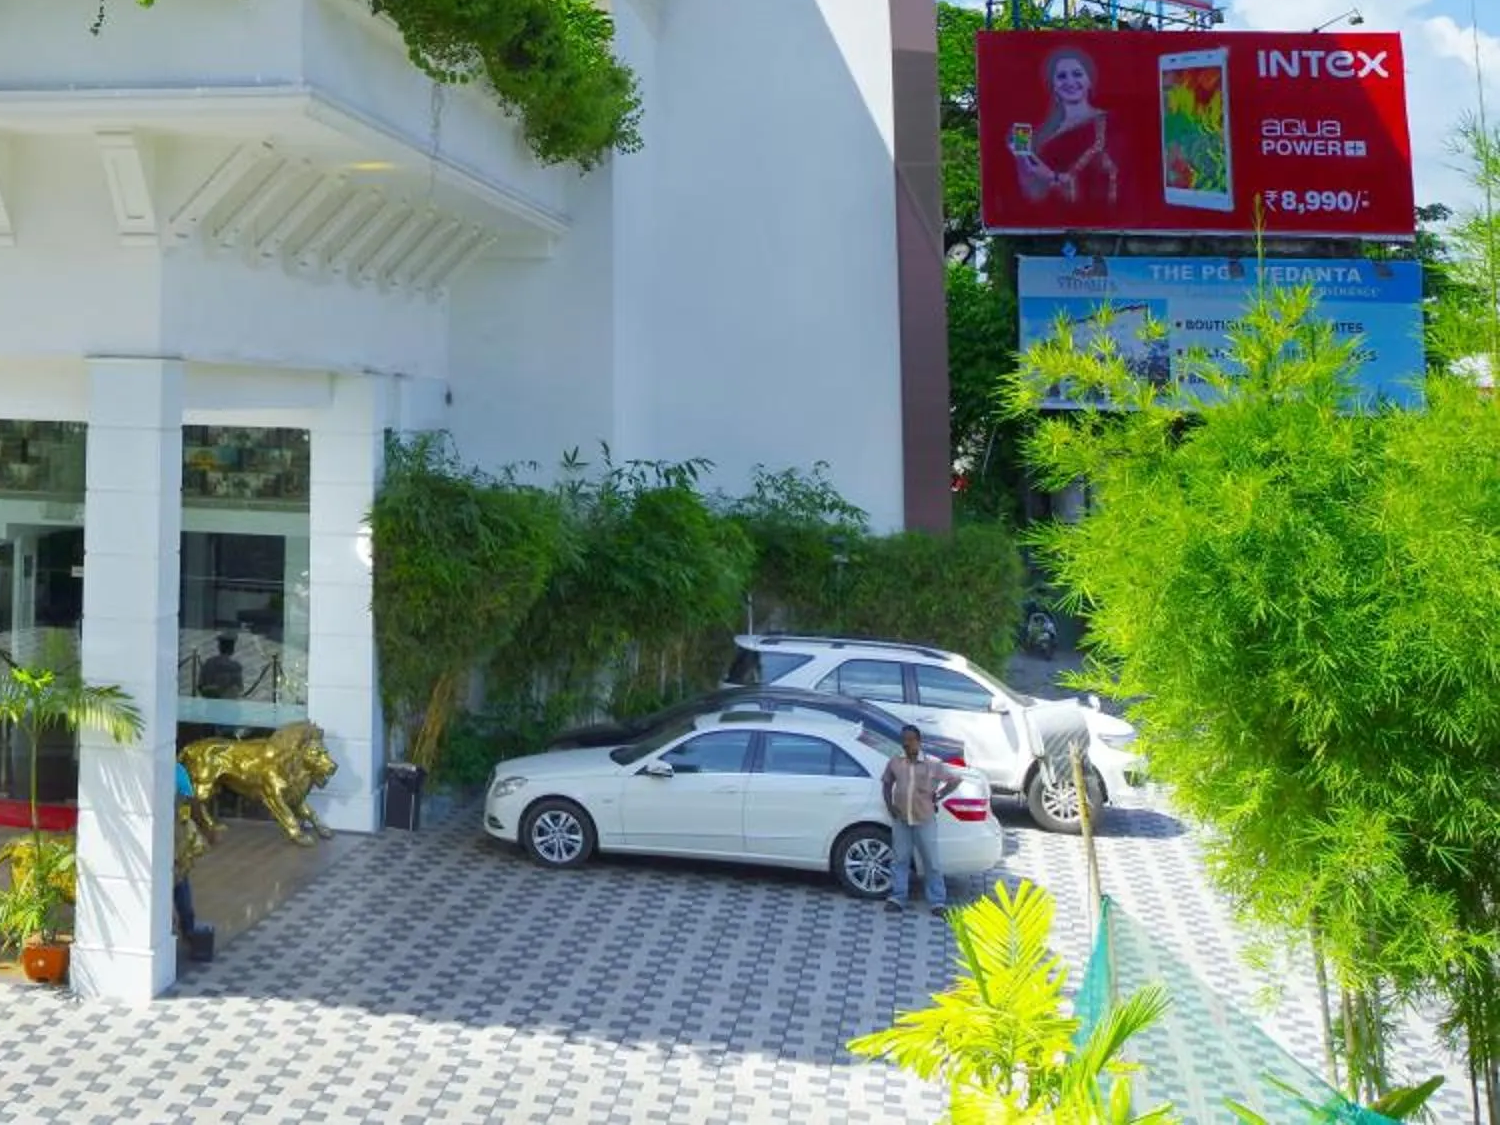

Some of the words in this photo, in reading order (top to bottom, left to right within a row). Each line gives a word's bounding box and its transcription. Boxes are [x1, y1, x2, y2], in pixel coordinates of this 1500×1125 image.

[1150, 264, 1192, 281] THE
[1202, 265, 1245, 281] PG
[1253, 266, 1363, 284] VEDANTA
